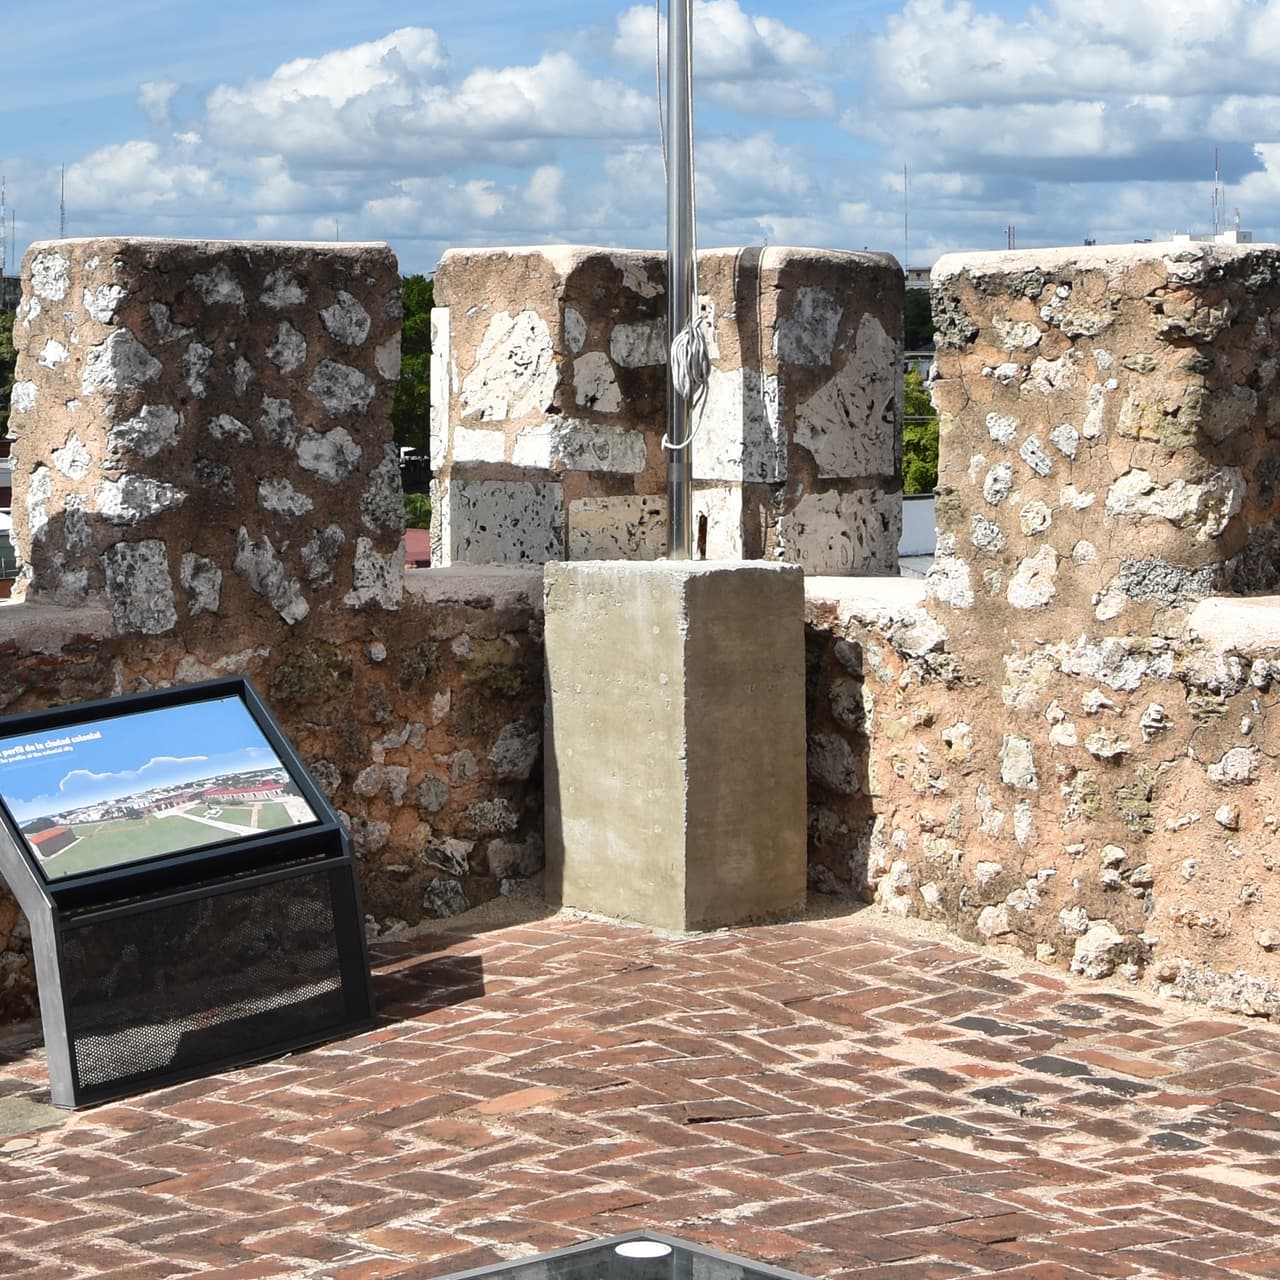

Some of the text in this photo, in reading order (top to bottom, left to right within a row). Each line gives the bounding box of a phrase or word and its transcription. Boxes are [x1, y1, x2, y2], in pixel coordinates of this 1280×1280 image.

[2, 745, 25, 757] perfil
[25, 743, 36, 751] de
[45, 737, 71, 747] ciudad
[71, 731, 102, 742] colonial
